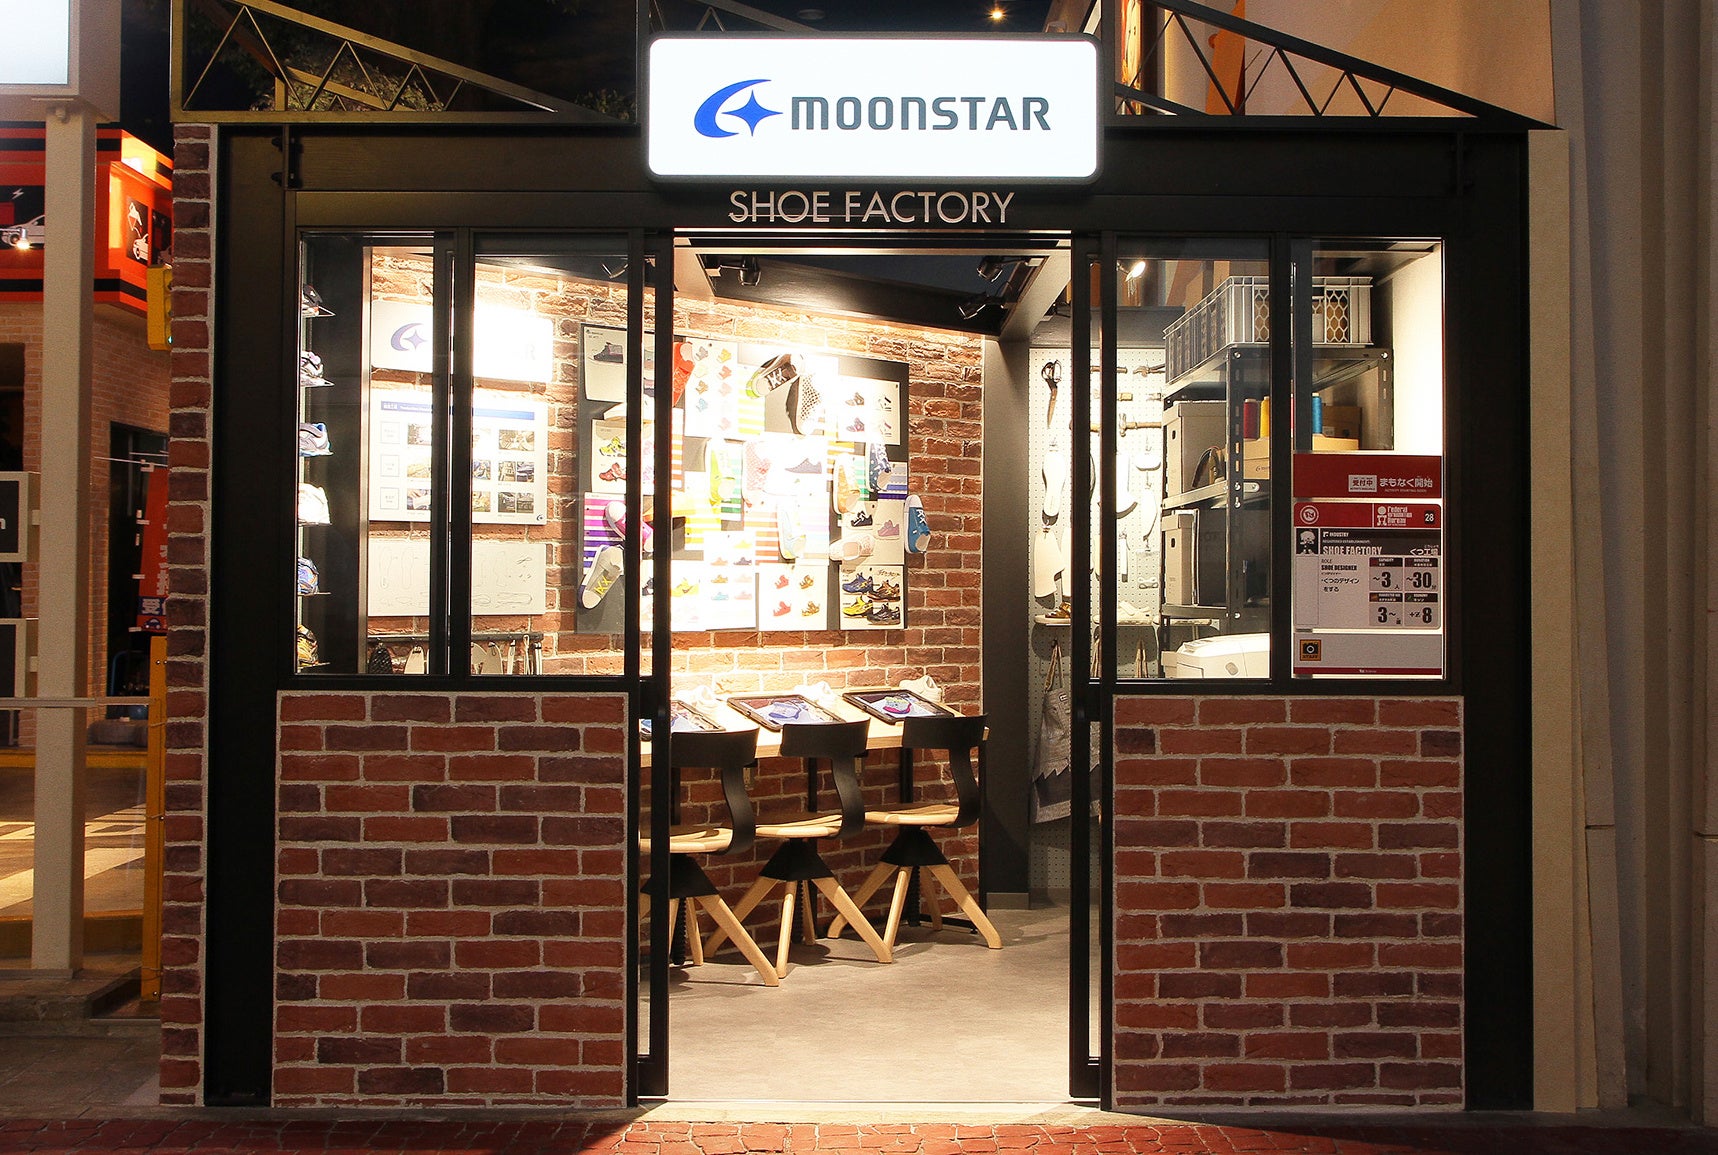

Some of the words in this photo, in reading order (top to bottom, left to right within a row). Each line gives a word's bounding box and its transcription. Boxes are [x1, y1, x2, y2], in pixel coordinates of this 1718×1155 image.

[791, 96, 1052, 131] MOONSTAR
[728, 190, 830, 224] SHOE
[844, 191, 1016, 224] FACTORY
[1352, 479, 1374, 487] 受付中
[1379, 477, 1433, 488] まもなく開始
[1424, 513, 1434, 522] 28
[1322, 546, 1345, 555] SHOE
[1346, 546, 1382, 555] FACTORY
